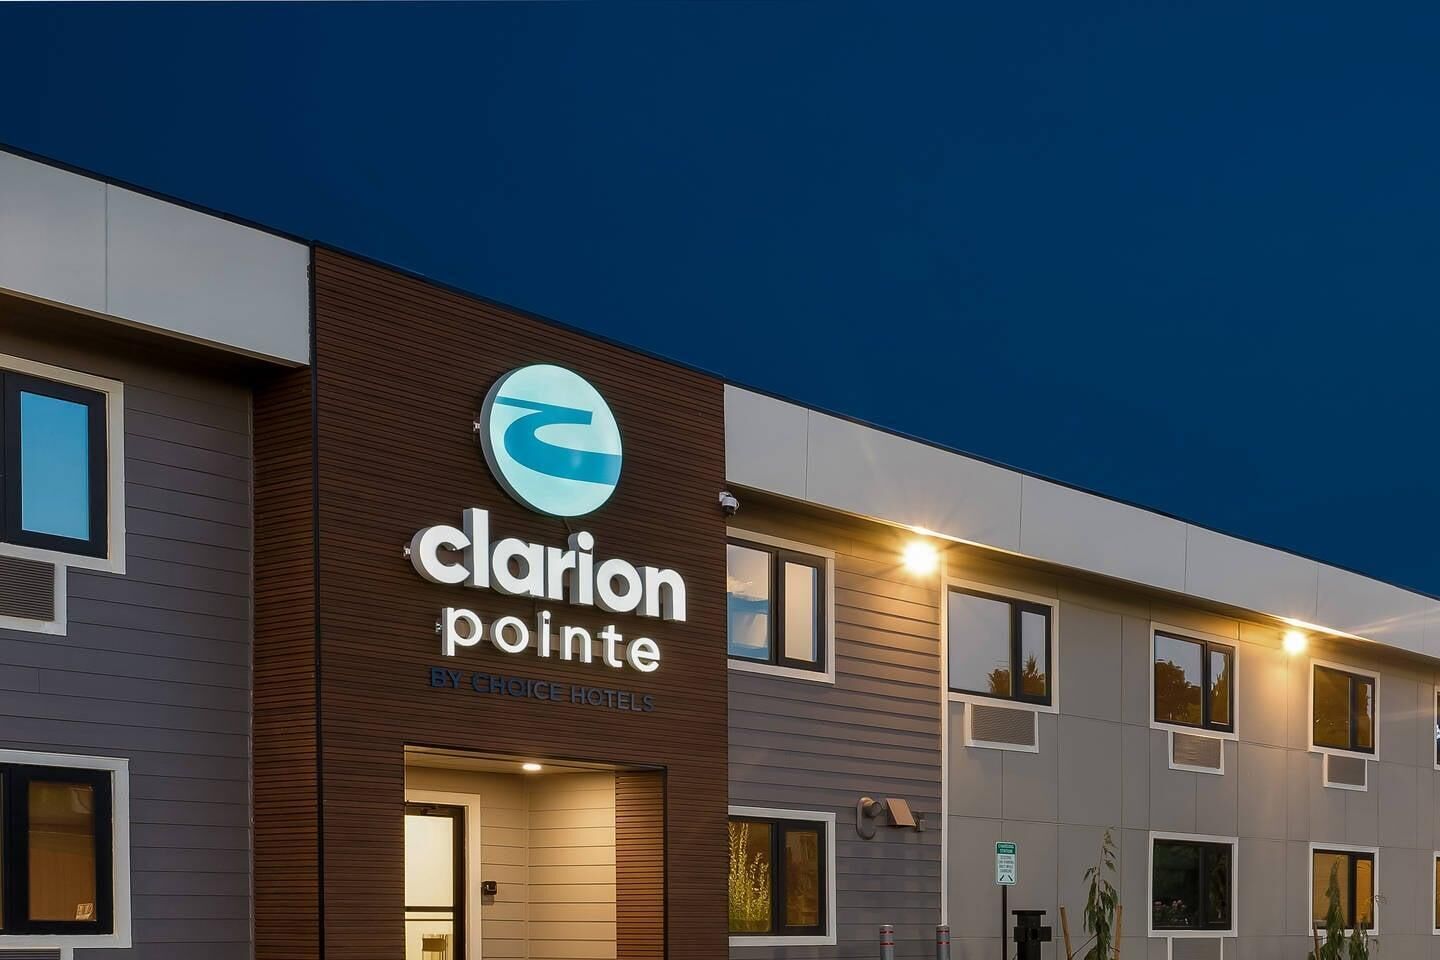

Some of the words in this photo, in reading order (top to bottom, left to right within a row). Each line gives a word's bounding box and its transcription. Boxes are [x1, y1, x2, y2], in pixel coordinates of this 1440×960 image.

[409, 507, 687, 622] clarion
[441, 606, 661, 672] pointe
[430, 667, 463, 688] BY
[472, 672, 562, 700] CHOICE
[571, 685, 656, 712] HOTELS
